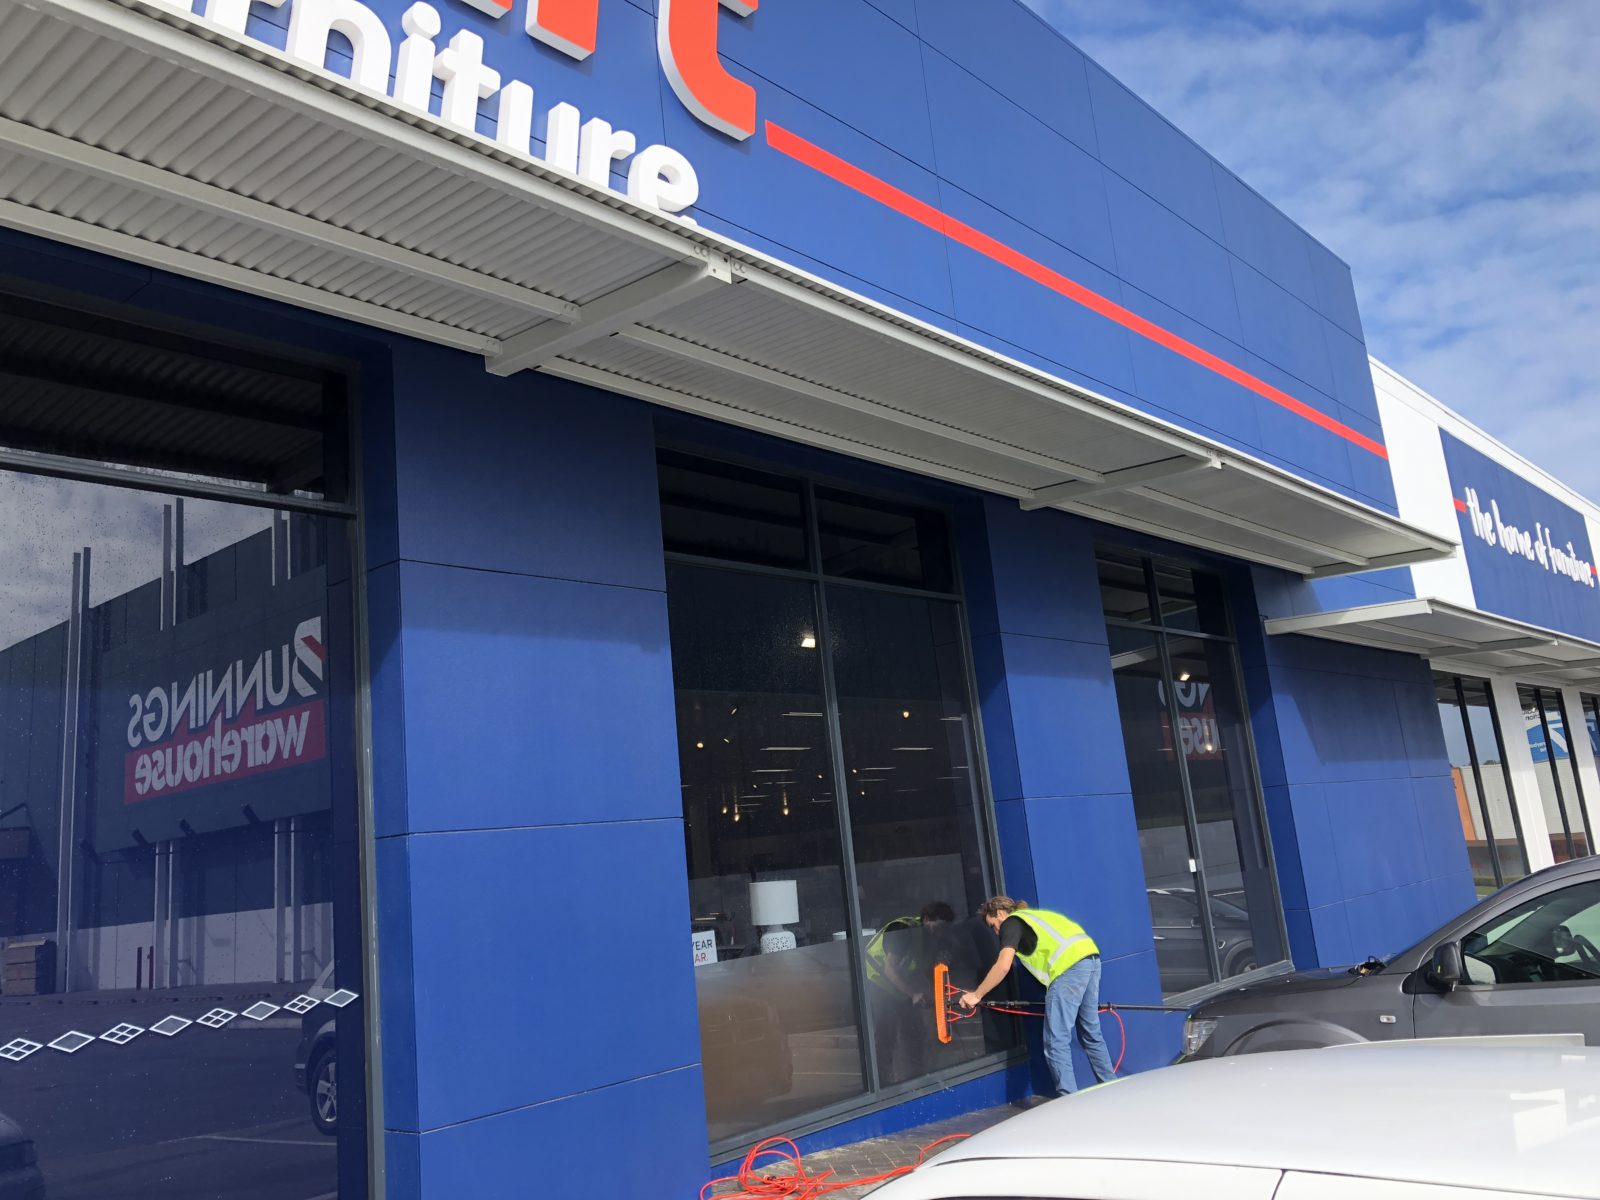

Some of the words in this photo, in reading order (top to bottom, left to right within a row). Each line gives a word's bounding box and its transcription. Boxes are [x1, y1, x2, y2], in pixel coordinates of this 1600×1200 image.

[1464, 486, 1496, 547] the
[1491, 499, 1535, 561] home
[1534, 522, 1549, 570] of
